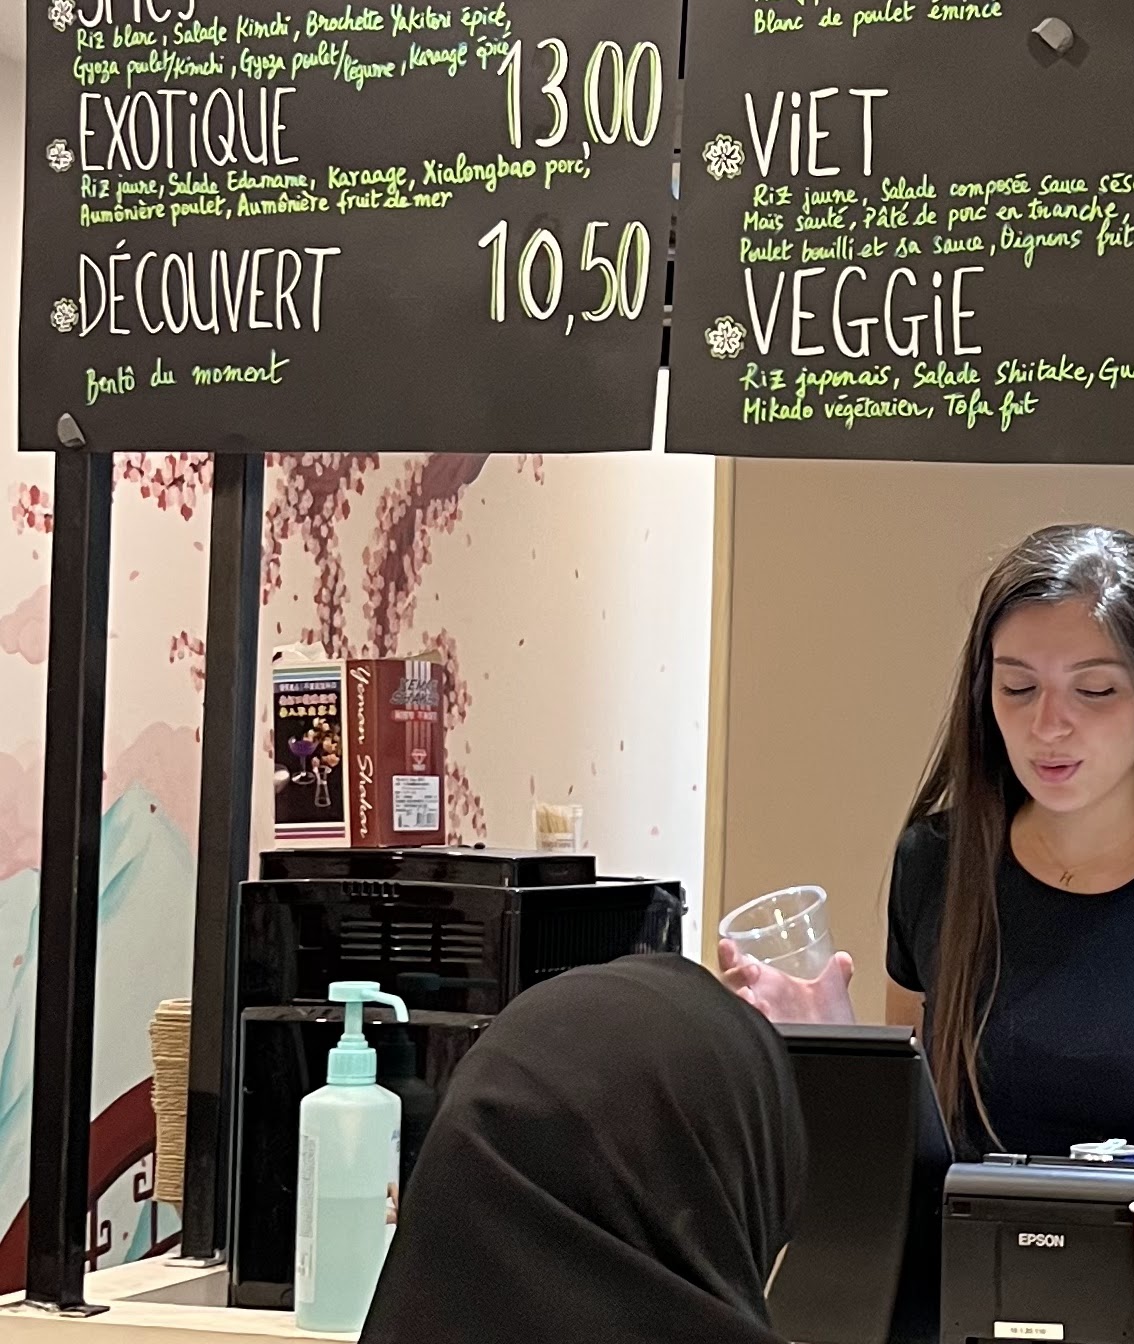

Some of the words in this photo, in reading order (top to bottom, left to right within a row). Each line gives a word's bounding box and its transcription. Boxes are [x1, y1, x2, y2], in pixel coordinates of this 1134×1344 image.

[77, 28, 105, 52] Riz
[173, 16, 227, 46] Salade
[306, 4, 384, 38] Brochette
[390, 3, 452, 37] Yakitori
[754, 9, 804, 35] Blanc
[818, 7, 843, 28] de
[852, 0, 916, 37] poulet
[73, 56, 120, 86] Gyoza
[240, 47, 286, 80] Gyoza
[497, 38, 663, 157] 13,00
[81, 173, 110, 198] Riz
[168, 171, 219, 196] Salade
[423, 152, 536, 193] Xialongbao
[753, 183, 793, 207] Riz
[881, 173, 937, 202] Salade
[950, 173, 1031, 205] composée
[80, 199, 165, 227] Aumônière
[237, 191, 330, 217] Aumônière
[337, 188, 383, 214] fruit
[414, 190, 453, 208] mer
[862, 202, 908, 229] Pâté
[912, 202, 937, 226] de
[948, 206, 987, 231] porc
[996, 206, 1023, 221] en
[740, 237, 794, 263] Poulet
[802, 235, 855, 263] bouilli
[857, 236, 888, 258] et
[1000, 223, 1083, 268] Oignons
[79, 238, 341, 337] DÉCOUVERT
[478, 220, 650, 335] 10,50
[86, 366, 136, 405] Bentô
[150, 357, 177, 387] du
[192, 349, 289, 385] moment
[739, 362, 787, 391] Riz
[913, 361, 980, 388] Salade
[743, 397, 814, 424] Mikado
[943, 388, 994, 429] Tofu
[998, 391, 1039, 432] frit
[1018, 1232, 1065, 1248] EPSON
